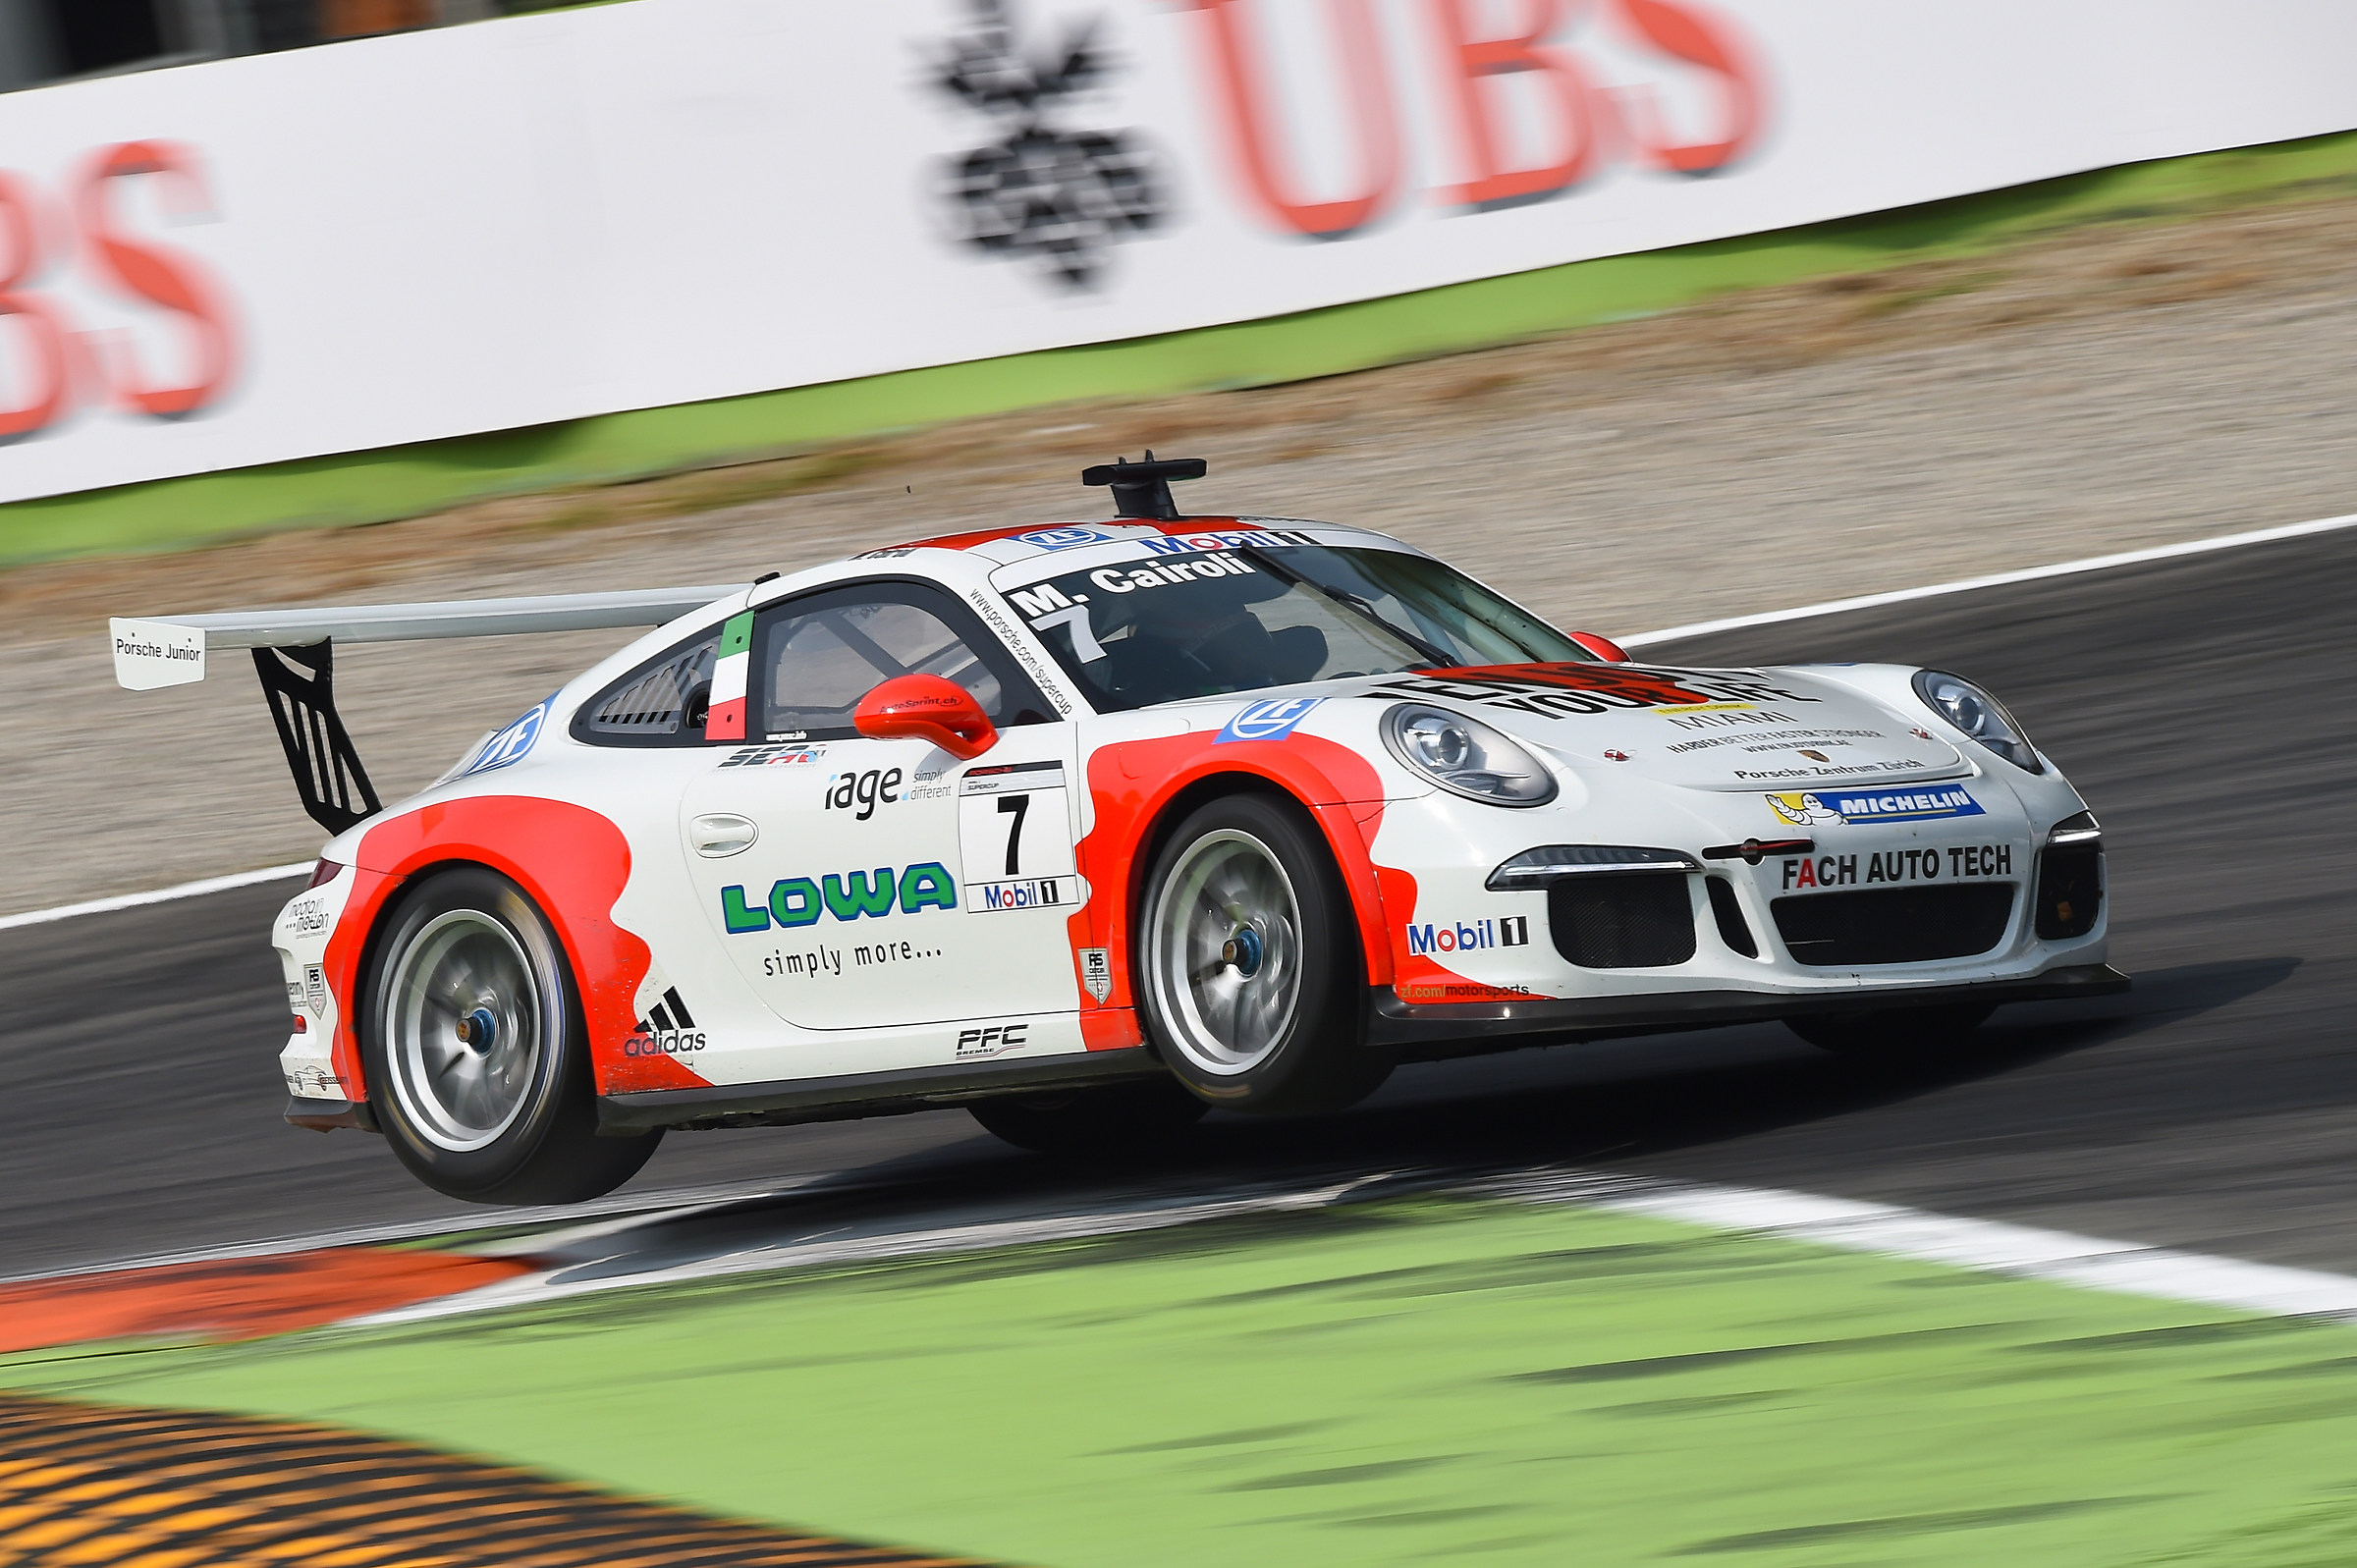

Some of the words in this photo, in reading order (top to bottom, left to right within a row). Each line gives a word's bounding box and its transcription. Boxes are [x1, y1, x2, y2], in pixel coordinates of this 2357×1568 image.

[1183, 0, 1782, 242] UBS
[1138, 532, 1280, 555] Mobil
[1273, 531, 1321, 546] 1
[1009, 583, 1090, 618] M.
[1089, 553, 1256, 594] Cairoli
[1028, 604, 1108, 664] 7
[116, 638, 162, 658] Porsche
[166, 643, 201, 662] Junior
[969, 588, 1072, 715] www.porsche.com/supercup
[1481, 683, 1702, 720] YOUR
[1690, 682, 1823, 703] LIFE
[1667, 710, 1798, 730] MIAMI
[1666, 738, 1723, 754] HARDER
[1718, 732, 1772, 744] BETTER
[913, 768, 946, 784] simply
[1734, 768, 1810, 780] Porsche
[1810, 764, 1880, 776] Zentrum
[1877, 758, 1925, 771] Zürich
[910, 785, 952, 800] different
[1839, 789, 1972, 814] MICHELIN
[997, 793, 1030, 876] 7
[1782, 853, 1858, 891] FACH
[1865, 848, 1941, 884] AUTO
[1947, 843, 2012, 877] TECH
[721, 861, 958, 935] LOWA
[985, 882, 1039, 909] Mobil
[1041, 880, 1059, 904] 1
[1407, 918, 1495, 954] Mobil
[1502, 917, 1526, 946] 1
[763, 944, 842, 978] simply
[853, 939, 943, 966] more...
[1400, 983, 1530, 999] zf.com/motorsports
[624, 1029, 706, 1056] adidas
[957, 1024, 1029, 1051] PFC
